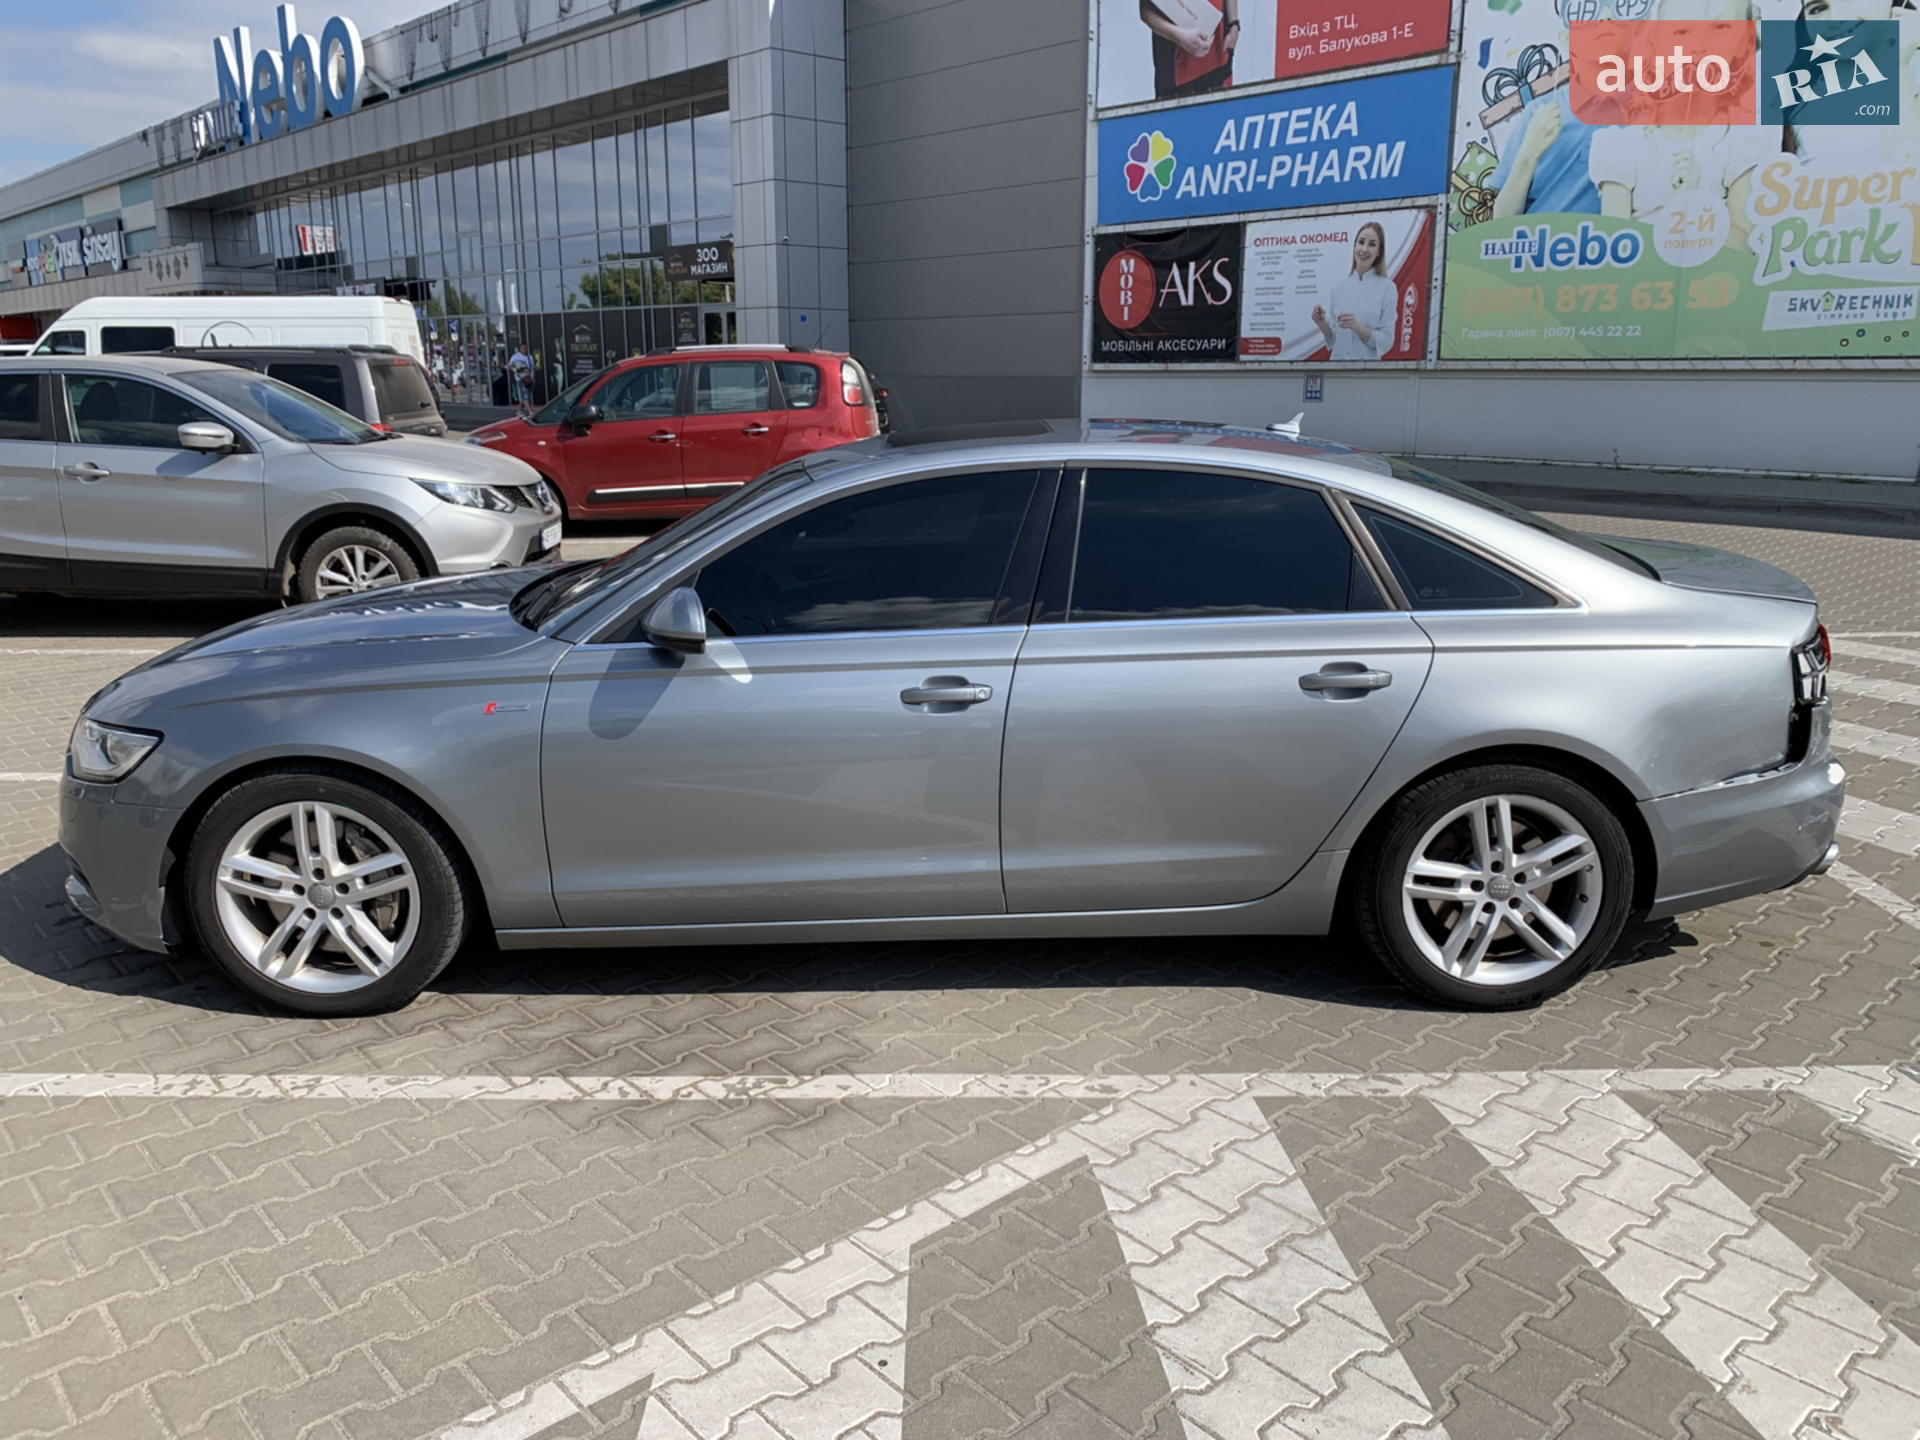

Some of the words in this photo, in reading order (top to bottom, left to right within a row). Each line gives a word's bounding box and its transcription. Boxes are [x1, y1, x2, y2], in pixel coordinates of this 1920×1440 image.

[1288, 45, 1315, 60] вул.
[1319, 30, 1388, 53] Балукова
[1391, 22, 1414, 40] 1-Е
[1289, 22, 1319, 39] Вхід
[1322, 21, 1330, 33] з
[1334, 13, 1358, 30] ТЦ,
[213, 3, 365, 150] Nebo
[1213, 101, 1358, 155] АПТЕКА
[1175, 140, 1406, 199] ANRI-PHARM
[1755, 161, 1918, 227] Super
[1254, 236, 1297, 248] ОПТИКА
[1300, 232, 1348, 244] ОКОМЕД
[1484, 240, 1538, 256] НАШЕ
[1514, 225, 1641, 269] Nebo
[1664, 238, 1716, 250] поверх
[1762, 207, 1903, 278] Park
[690, 262, 728, 275] МАГАЗИН
[1159, 258, 1232, 307] AKS
[1556, 283, 1619, 313] 873
[1631, 281, 1675, 311] 63
[1101, 340, 1154, 352] МОБІЛЬНІ
[1157, 338, 1226, 352] АКСЕСУАРИ
[1461, 328, 1503, 340] Гаряча
[1506, 326, 1540, 338] лінія:
[1544, 326, 1575, 339] (067)
[1579, 327, 1604, 338] 445
[1607, 326, 1622, 337] 22
[1626, 325, 1642, 337] 22
